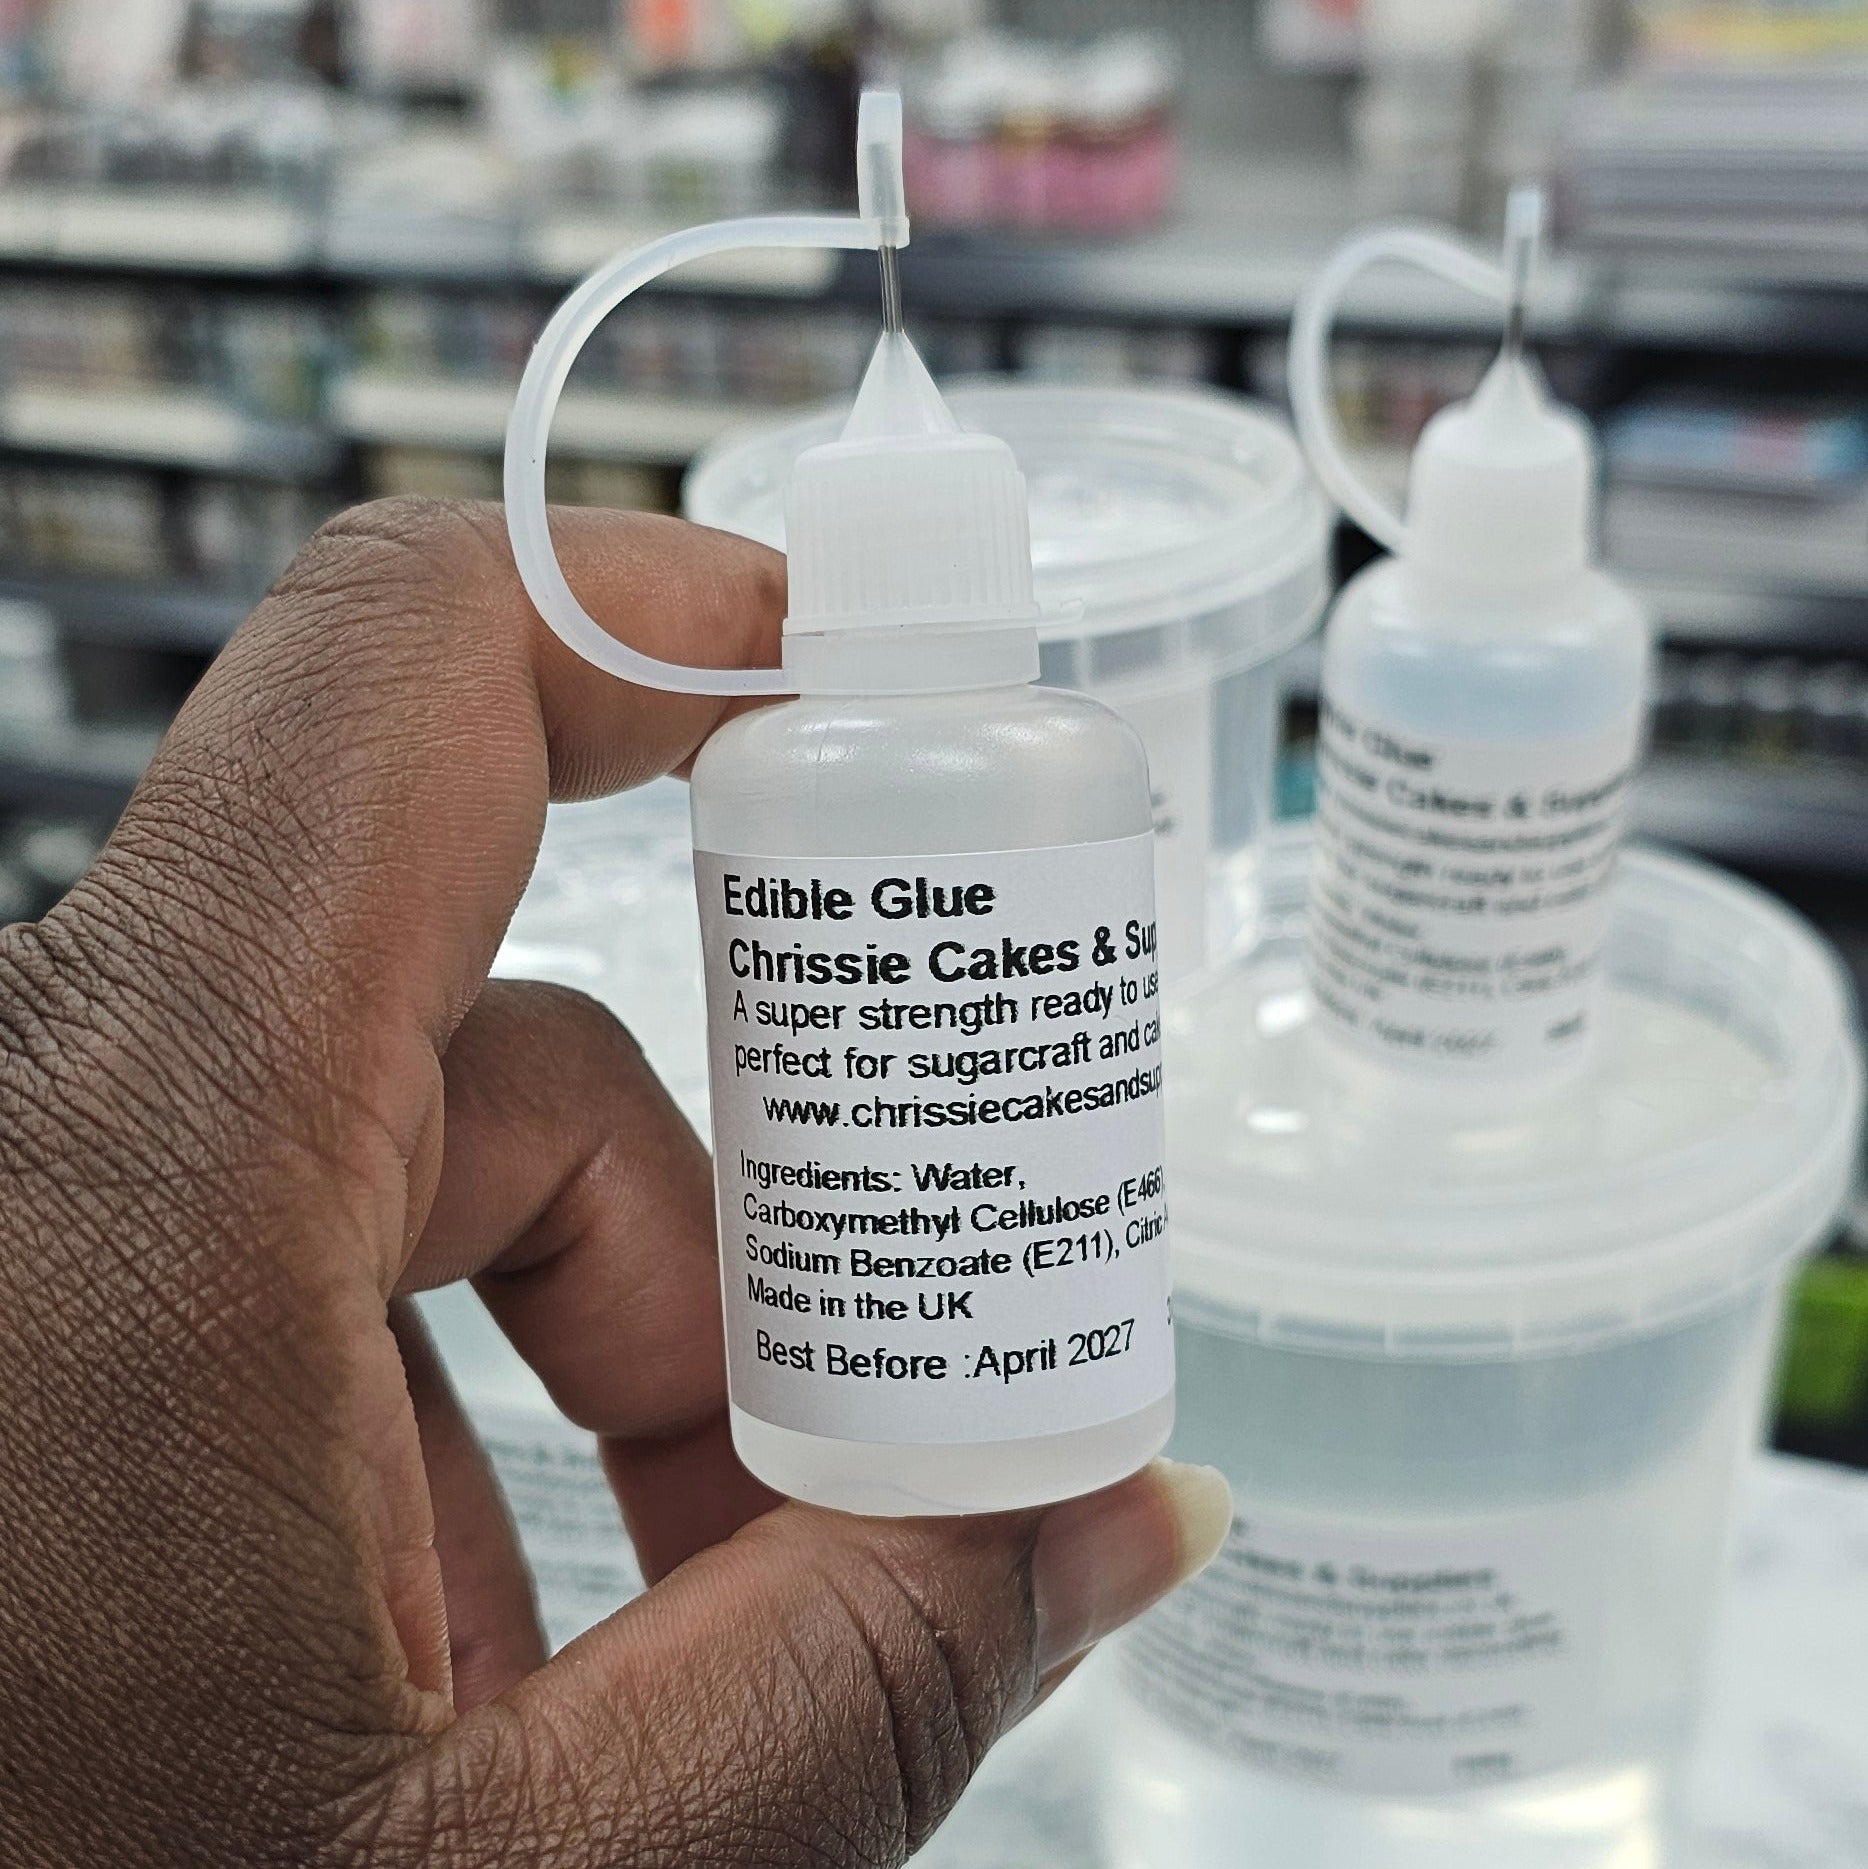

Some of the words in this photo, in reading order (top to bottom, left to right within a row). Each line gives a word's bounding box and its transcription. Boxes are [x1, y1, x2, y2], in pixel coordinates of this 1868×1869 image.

[724, 874, 856, 920] Edible
[871, 877, 996, 919] Glue
[729, 938, 911, 985] Chrissie
[929, 937, 1080, 983] Cakes
[1092, 926, 1118, 966] &
[734, 990, 748, 1023] A
[756, 1001, 847, 1037] super
[859, 992, 1019, 1036] strength
[1031, 980, 1114, 1021] ready
[1119, 975, 1138, 1006] to
[734, 1043, 833, 1078] perfect
[844, 1047, 897, 1080] for
[908, 1031, 1092, 1086] sugarcraft
[1098, 1019, 1140, 1060] and
[762, 1061, 1163, 1129] www.chrissiecakesandsup
[741, 1149, 902, 1192] Ingredients:
[911, 1163, 1026, 1192] Water,
[744, 1193, 962, 1242] Carboxymethyl
[971, 1190, 1110, 1234] Cellulose
[746, 1234, 841, 1276] Sodium
[851, 1249, 1012, 1278] Benzoate
[1022, 1228, 1120, 1279] (E211),
[1125, 1210, 1163, 1249] Citric
[748, 1273, 812, 1314] Made
[820, 1288, 847, 1318] in
[854, 1292, 910, 1320] the
[918, 1291, 974, 1321] UK
[757, 1328, 816, 1373] Best
[827, 1344, 948, 1380] Before
[1068, 1318, 1135, 1367] 2027
